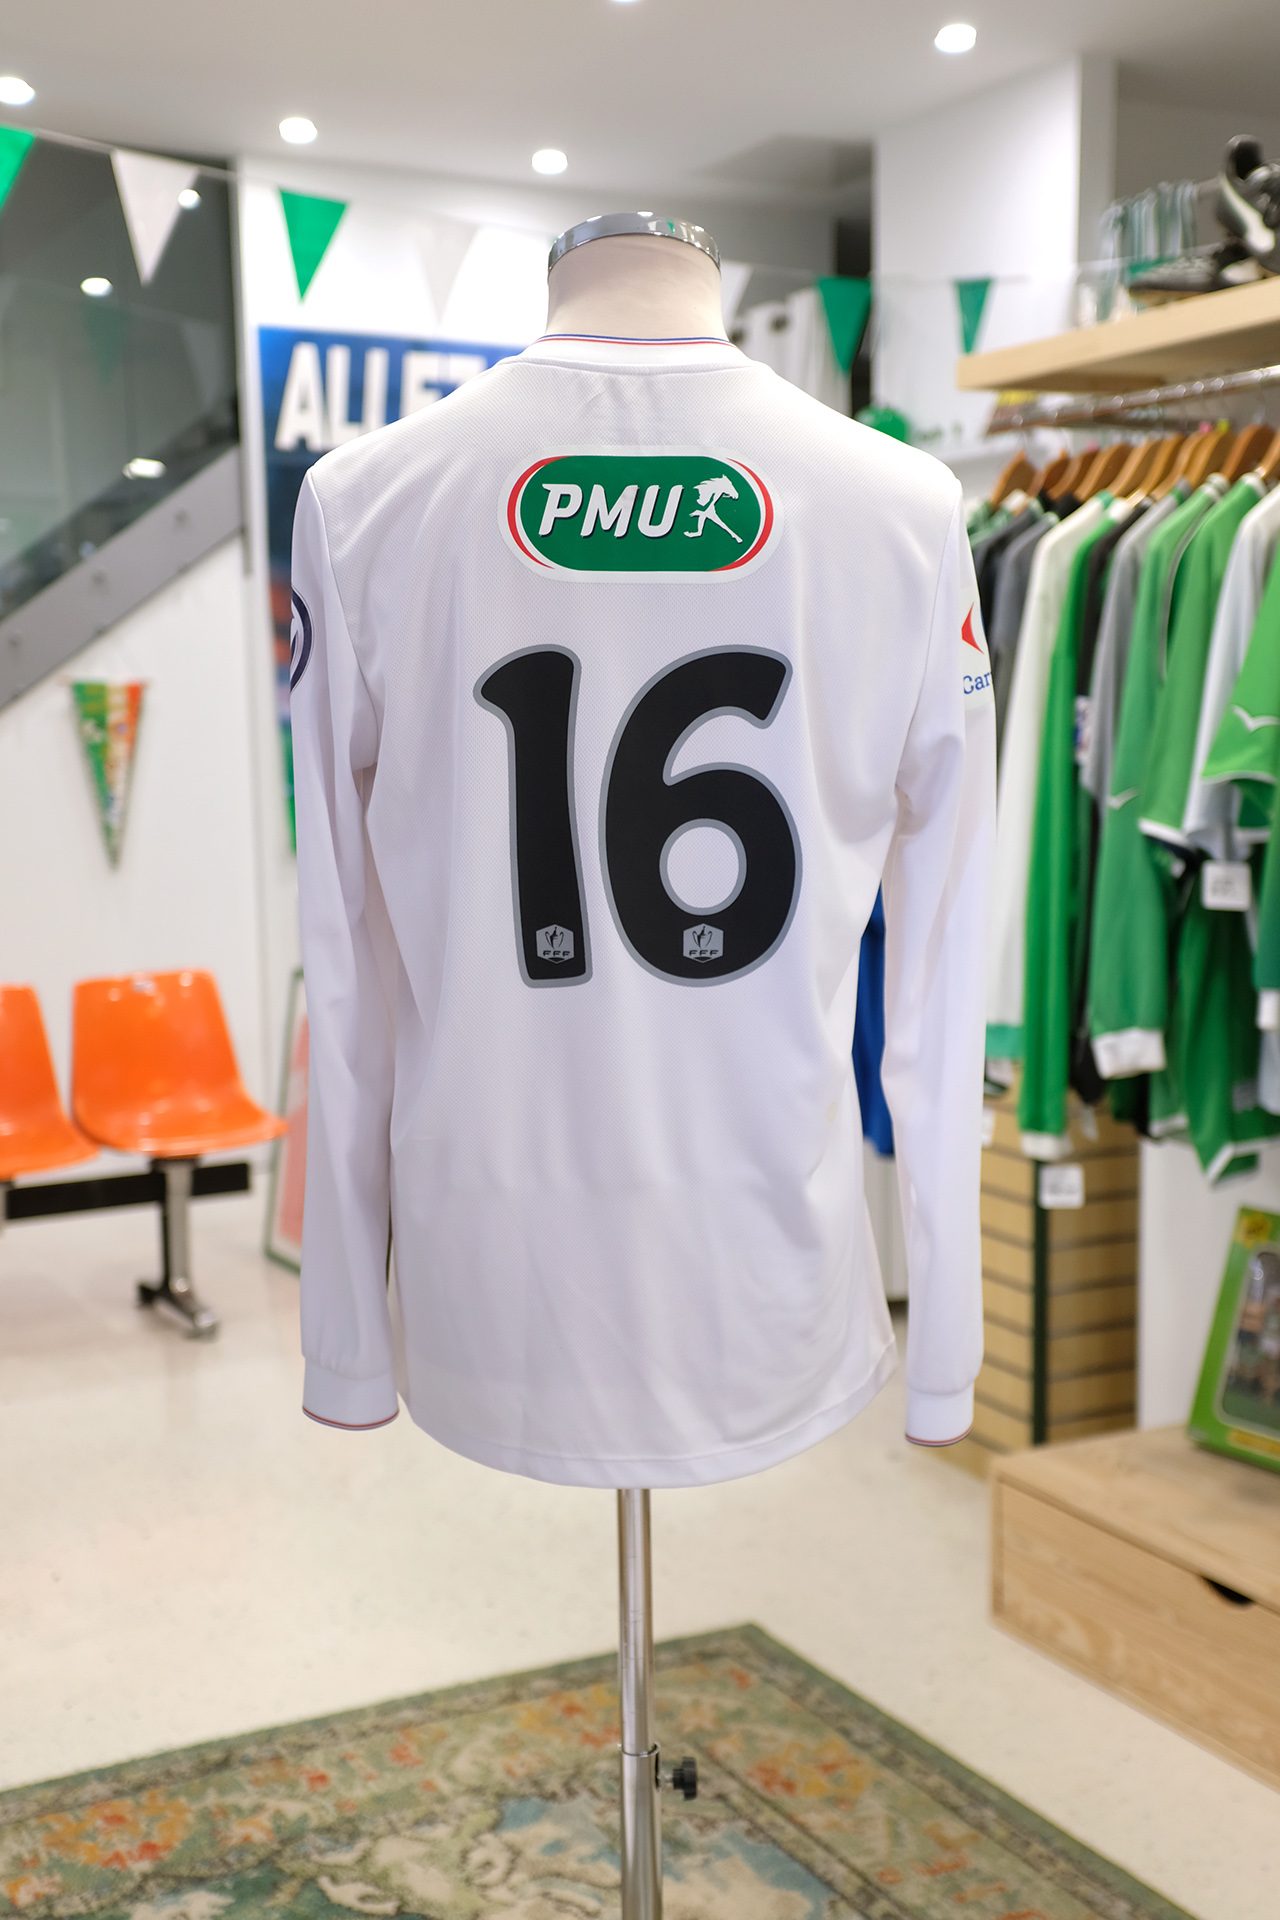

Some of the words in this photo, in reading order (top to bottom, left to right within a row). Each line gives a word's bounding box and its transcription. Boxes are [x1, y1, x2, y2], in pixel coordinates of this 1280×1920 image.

[538, 483, 685, 538] PMU
[963, 672, 991, 694] Car
[473, 644, 803, 988] 16
